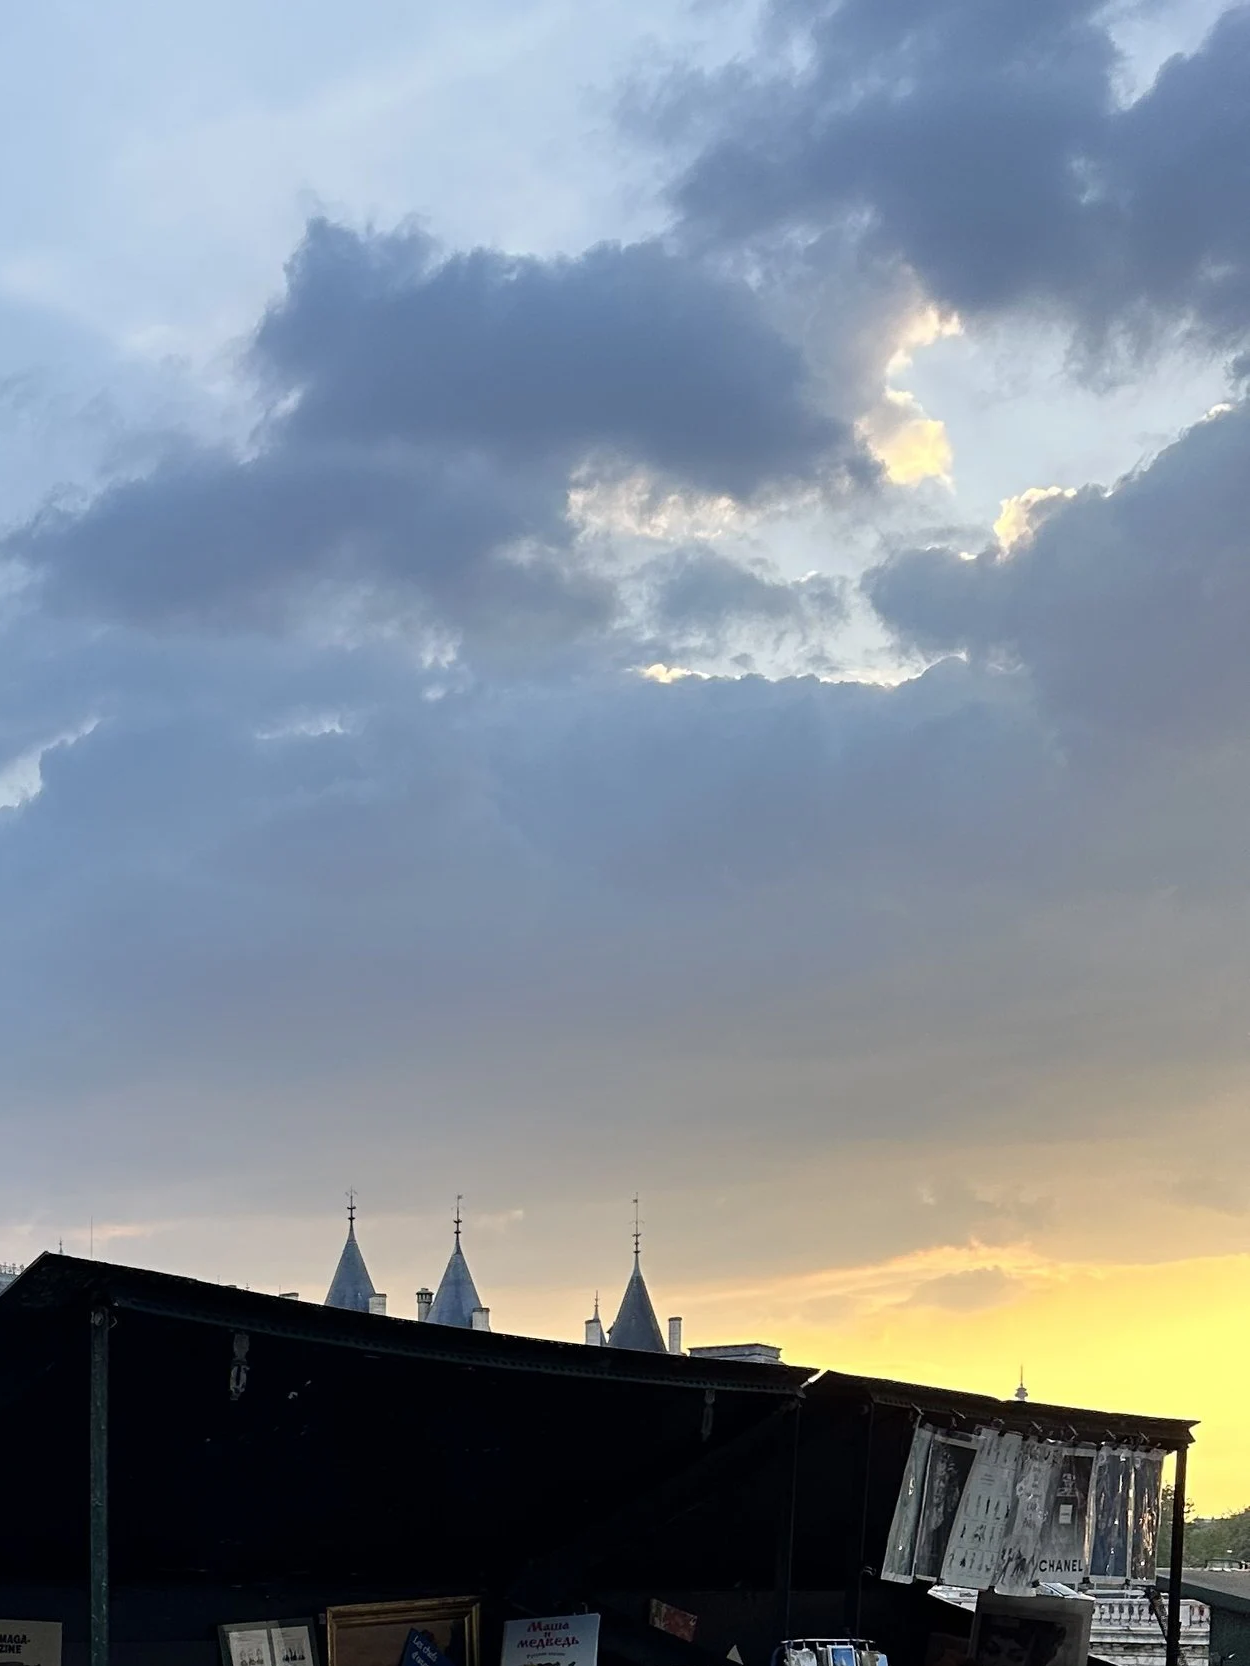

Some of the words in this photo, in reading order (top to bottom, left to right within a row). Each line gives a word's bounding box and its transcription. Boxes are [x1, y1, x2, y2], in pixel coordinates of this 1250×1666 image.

[1039, 1559, 1083, 1573] CHANEL
[526, 1621, 570, 1633] Маша
[0, 1644, 22, 1654] ZINE
